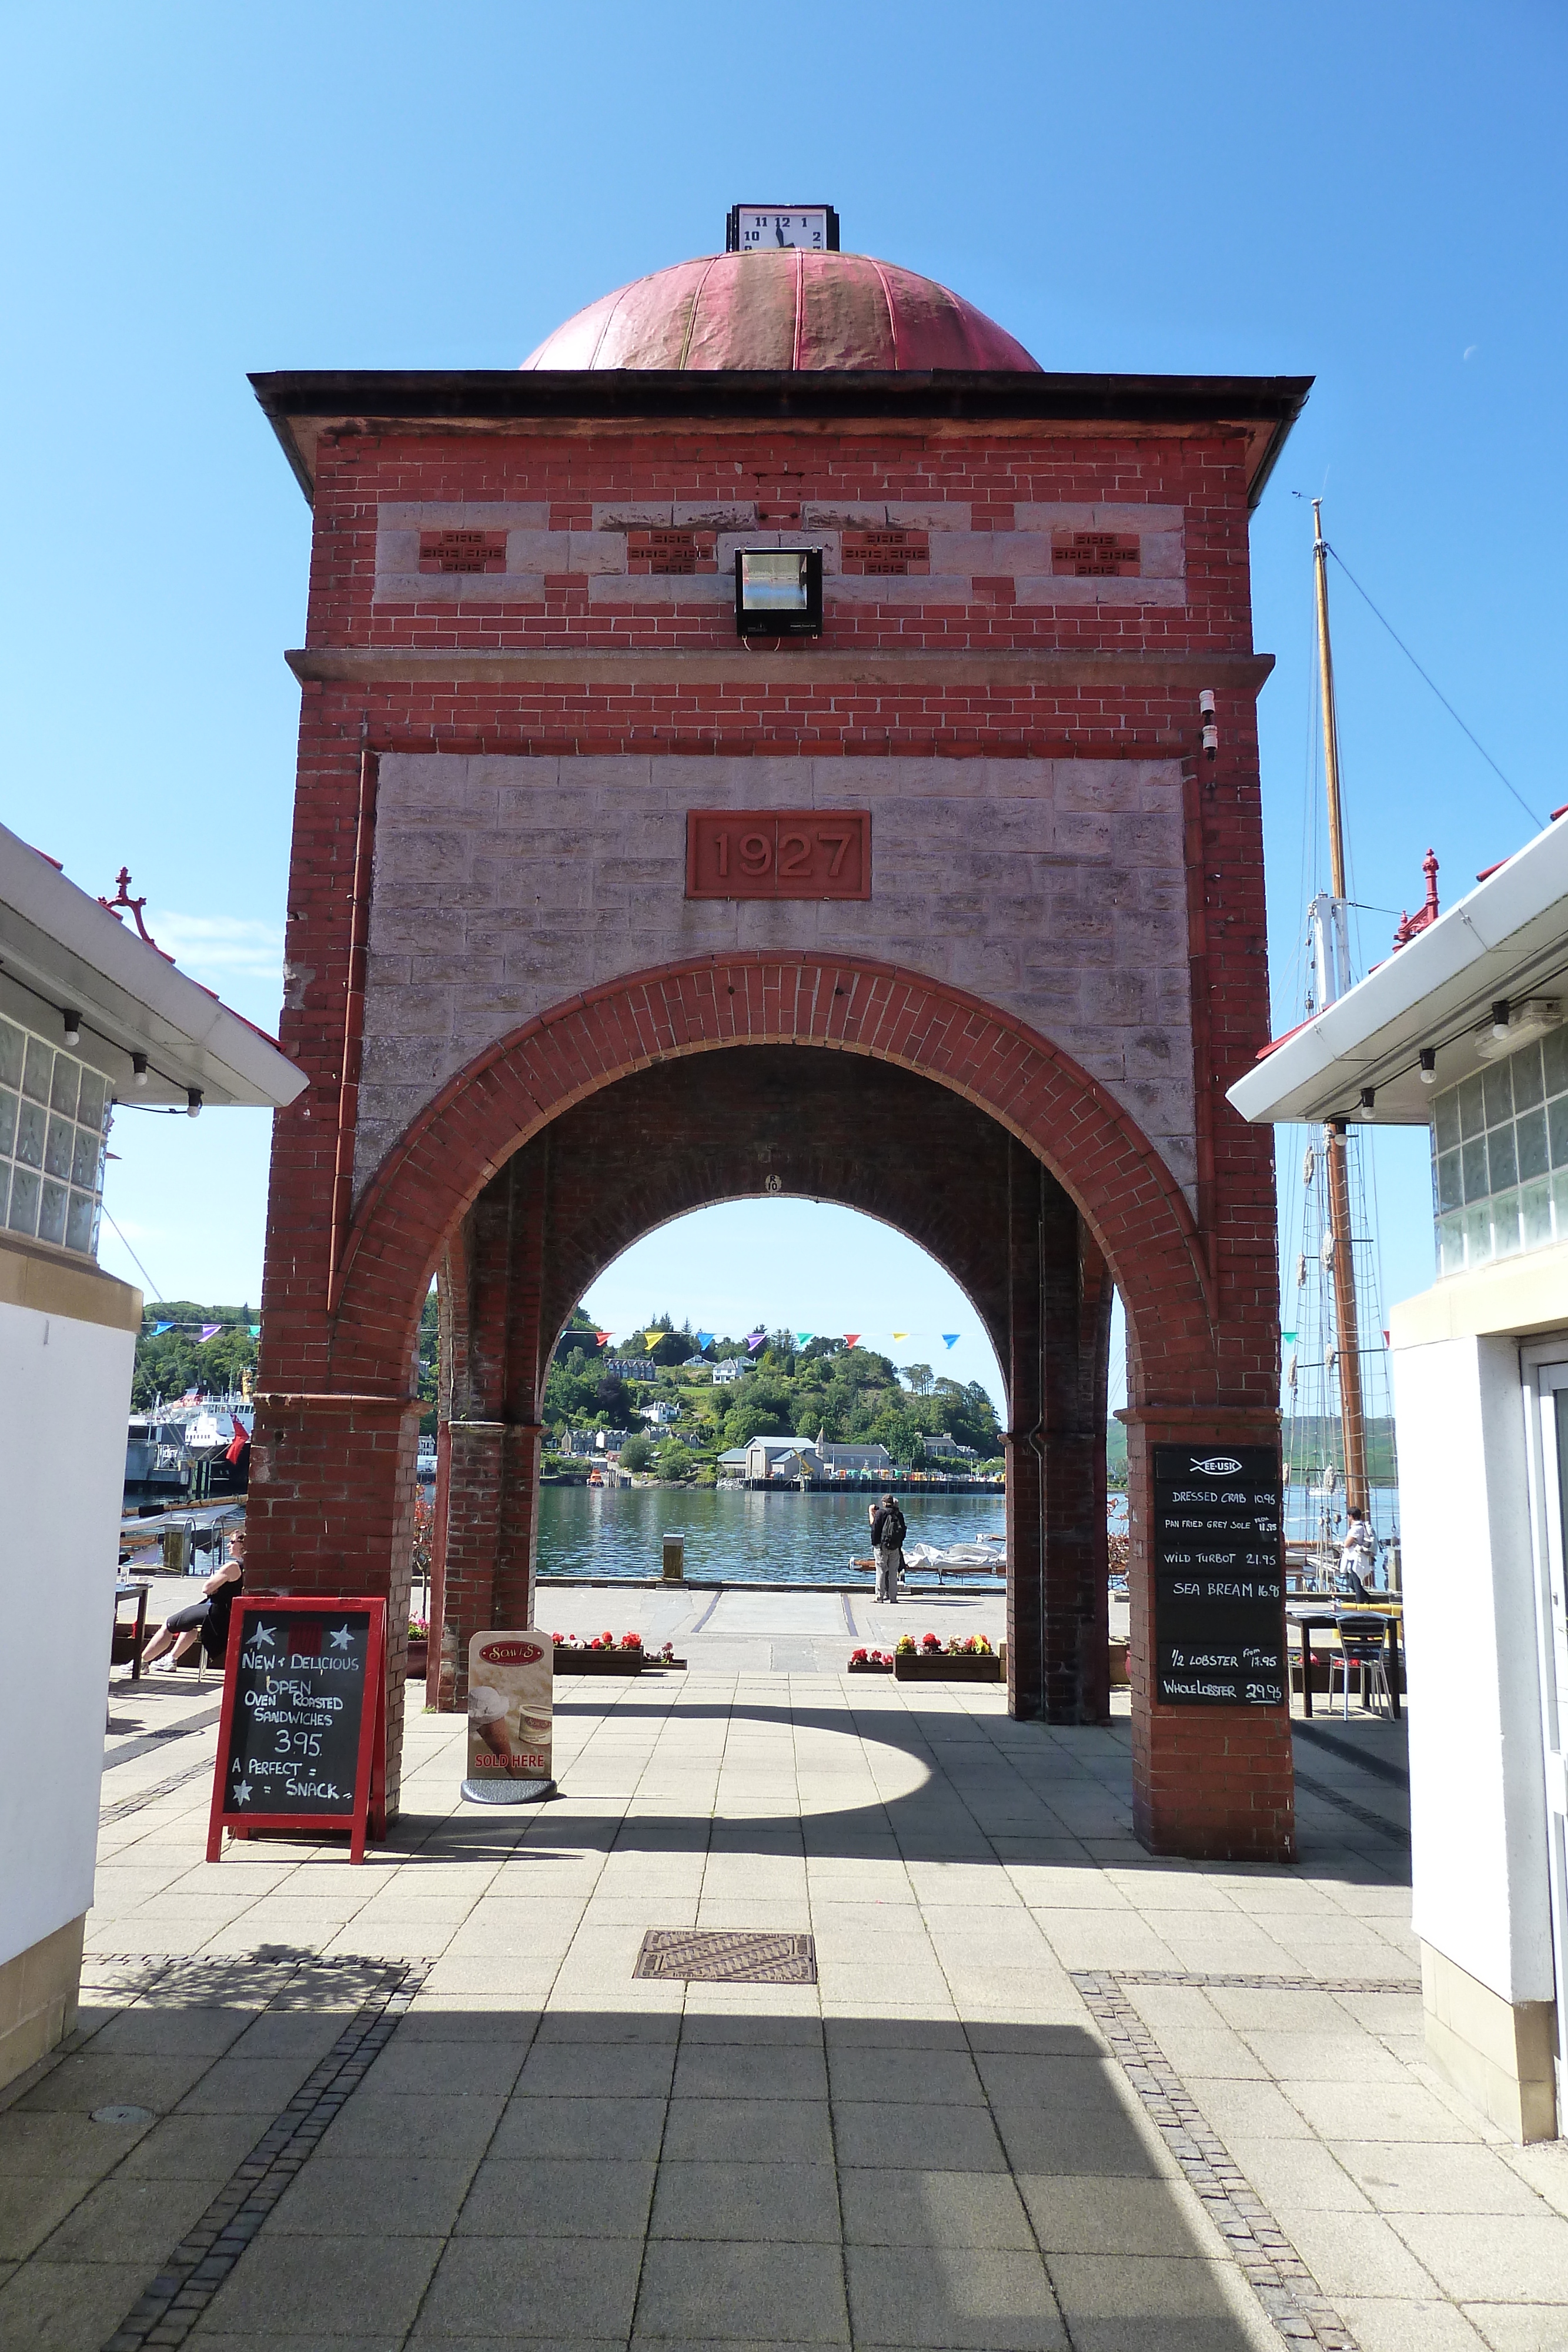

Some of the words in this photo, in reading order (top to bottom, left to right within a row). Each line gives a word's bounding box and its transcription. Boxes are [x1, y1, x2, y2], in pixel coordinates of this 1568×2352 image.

[755, 217, 767, 227] 11
[775, 217, 790, 228] 12
[801, 217, 808, 228] 1
[744, 231, 760, 241] 10
[813, 232, 821, 242] 2
[714, 831, 853, 876] 1927
[1172, 1491, 1218, 1502] DRESSED
[1221, 1492, 1246, 1503] CRAB
[1254, 1494, 1276, 1505] 10.95
[1165, 1519, 1179, 1529] PAN
[1206, 1521, 1228, 1529] GREY
[1259, 1523, 1277, 1532] 11.95
[1246, 1553, 1276, 1565] 21.95
[1173, 1583, 1200, 1596] SEA
[1208, 1583, 1253, 1598] BREAM
[242, 1651, 276, 1671] NEW
[290, 1653, 359, 1671] DELICIOUS
[1189, 1655, 1239, 1668] LOBSTER
[1251, 1656, 1278, 1668] 17.95
[266, 1679, 312, 1695] OPEN
[1245, 1683, 1282, 1699] 29.95
[245, 1690, 276, 1706] OVEN
[293, 1690, 343, 1710] ROASTED
[253, 1708, 333, 1726] SANDWICHES
[232, 1757, 241, 1773] A
[248, 1758, 303, 1776] PERFECT
[475, 1754, 508, 1768] SOLD
[511, 1755, 544, 1768] HERE
[285, 1778, 340, 1800] SNACK
